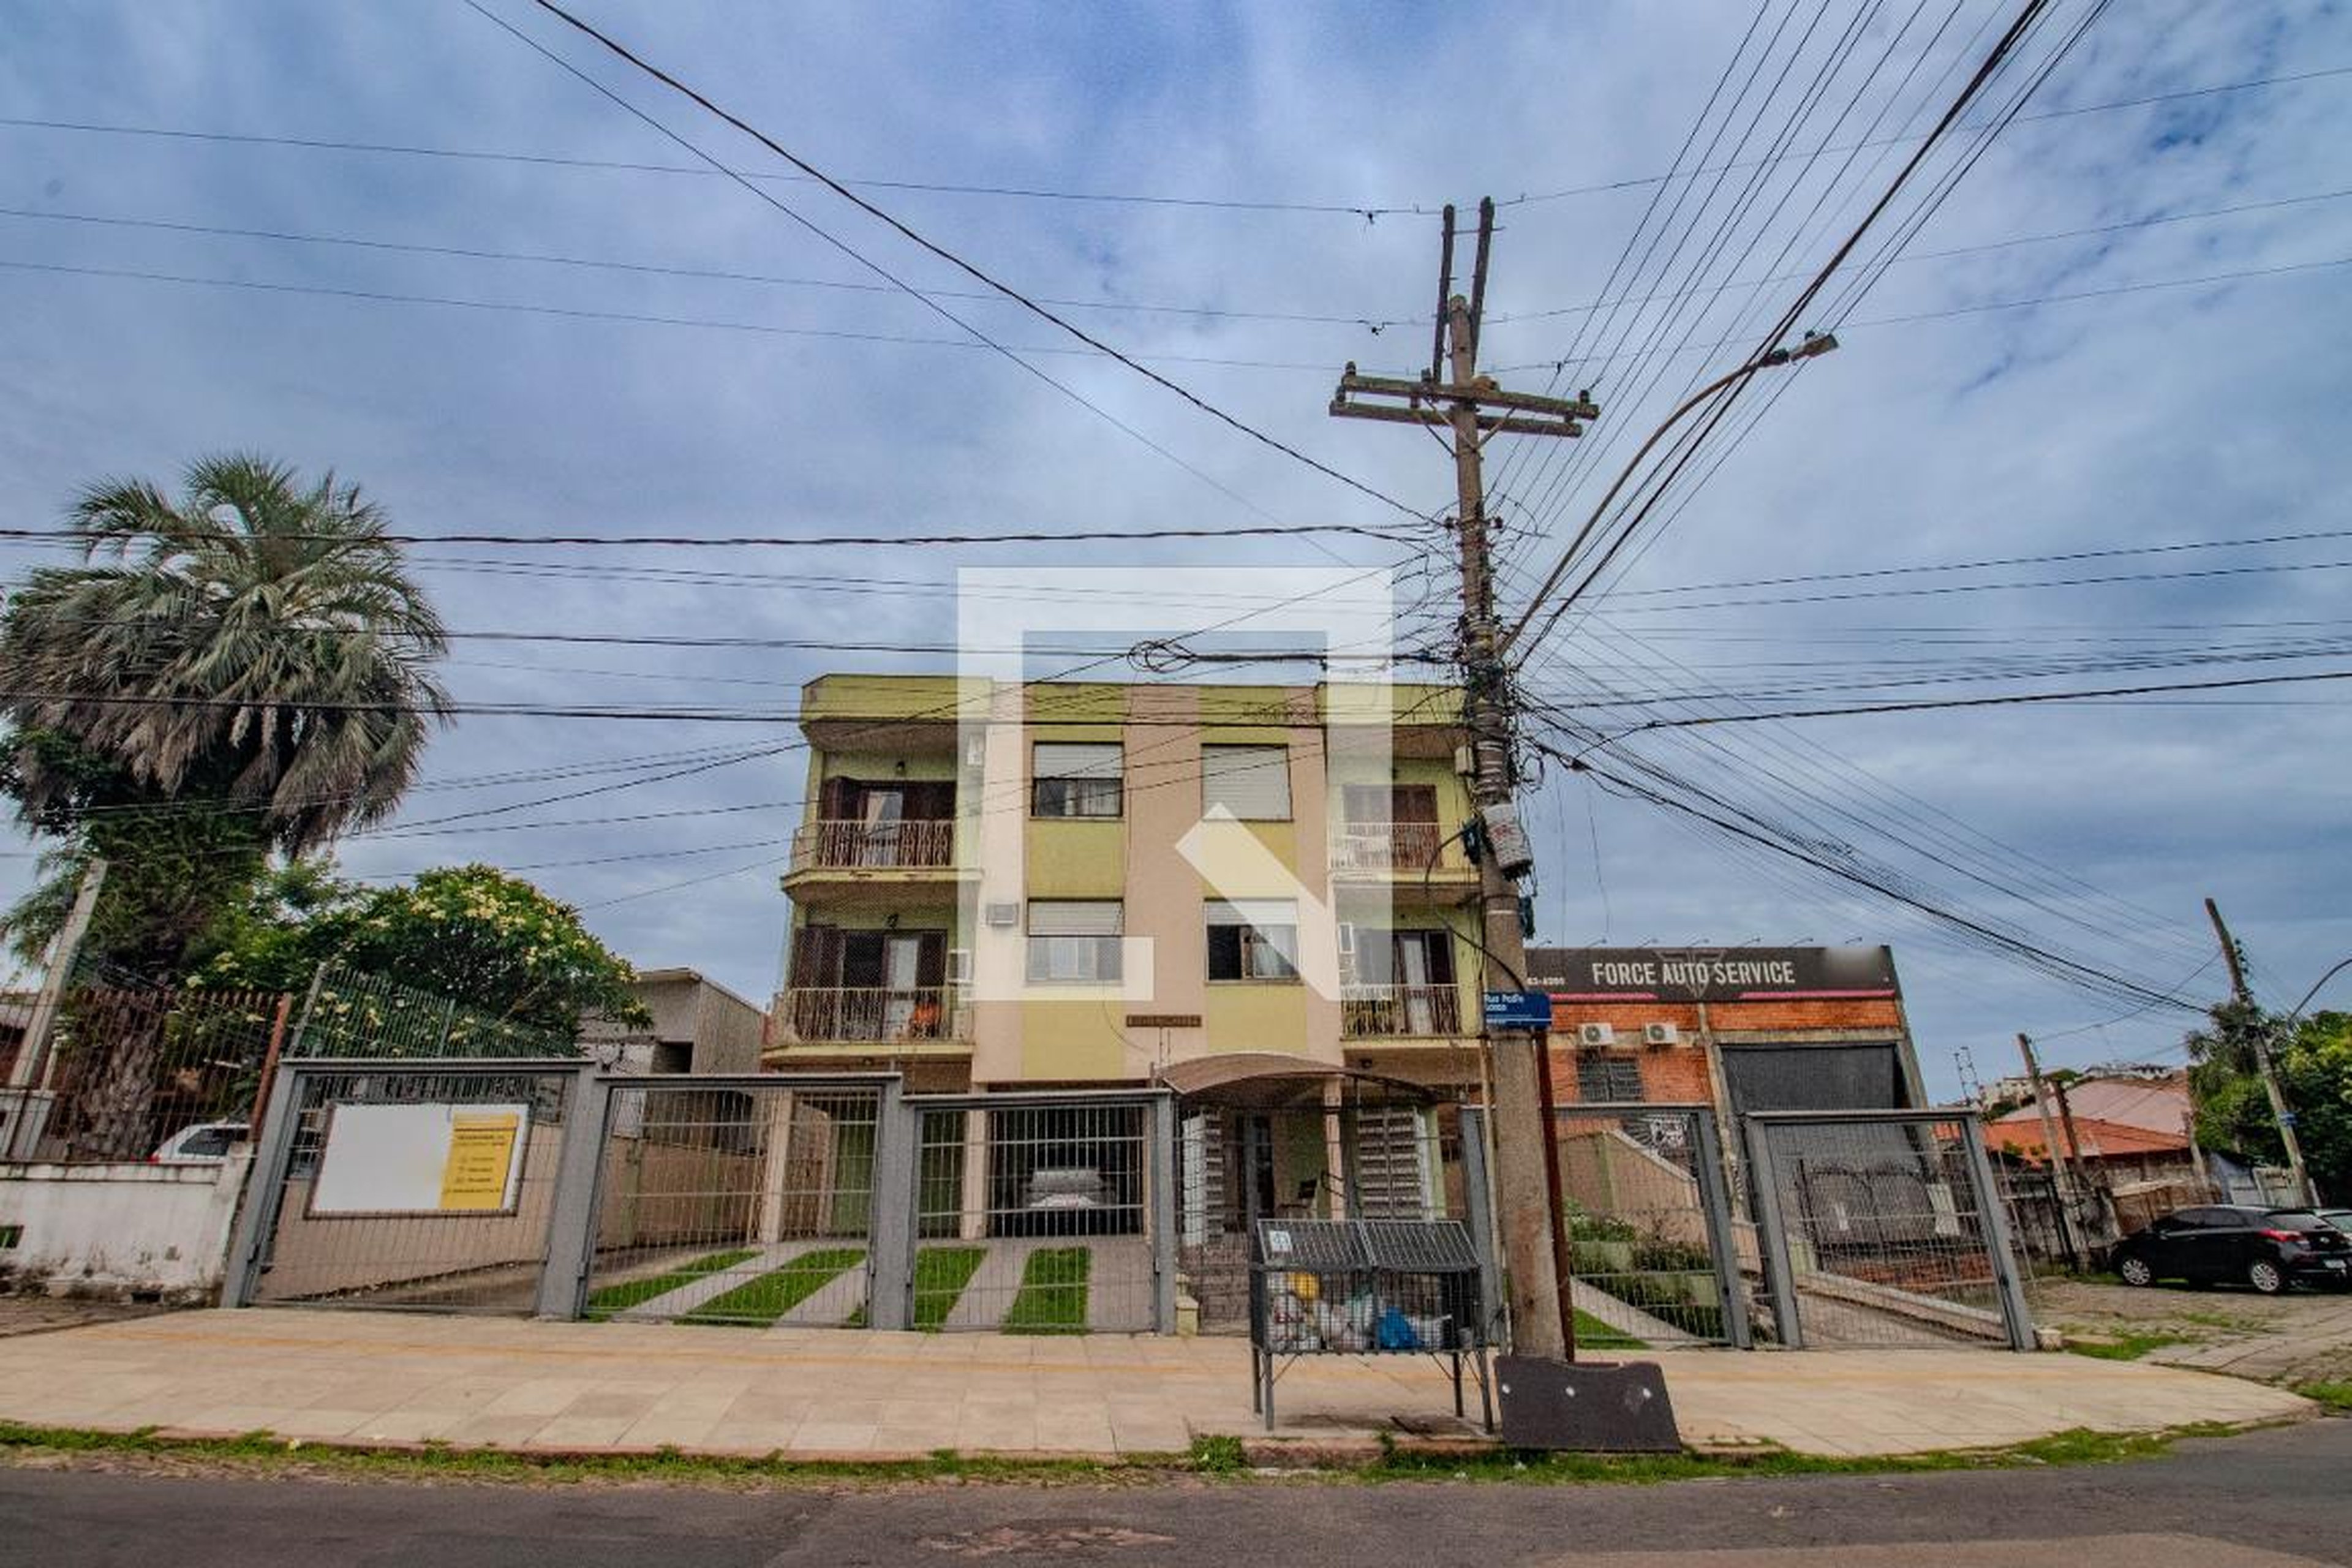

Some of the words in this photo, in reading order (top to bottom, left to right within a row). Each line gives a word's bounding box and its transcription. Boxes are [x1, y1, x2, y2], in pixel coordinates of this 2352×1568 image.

[1593, 963, 1657, 986] FORCE
[1662, 963, 1709, 985] AUTO
[1715, 961, 1796, 984] SERVICE
[1483, 993, 1499, 1003] Rua
